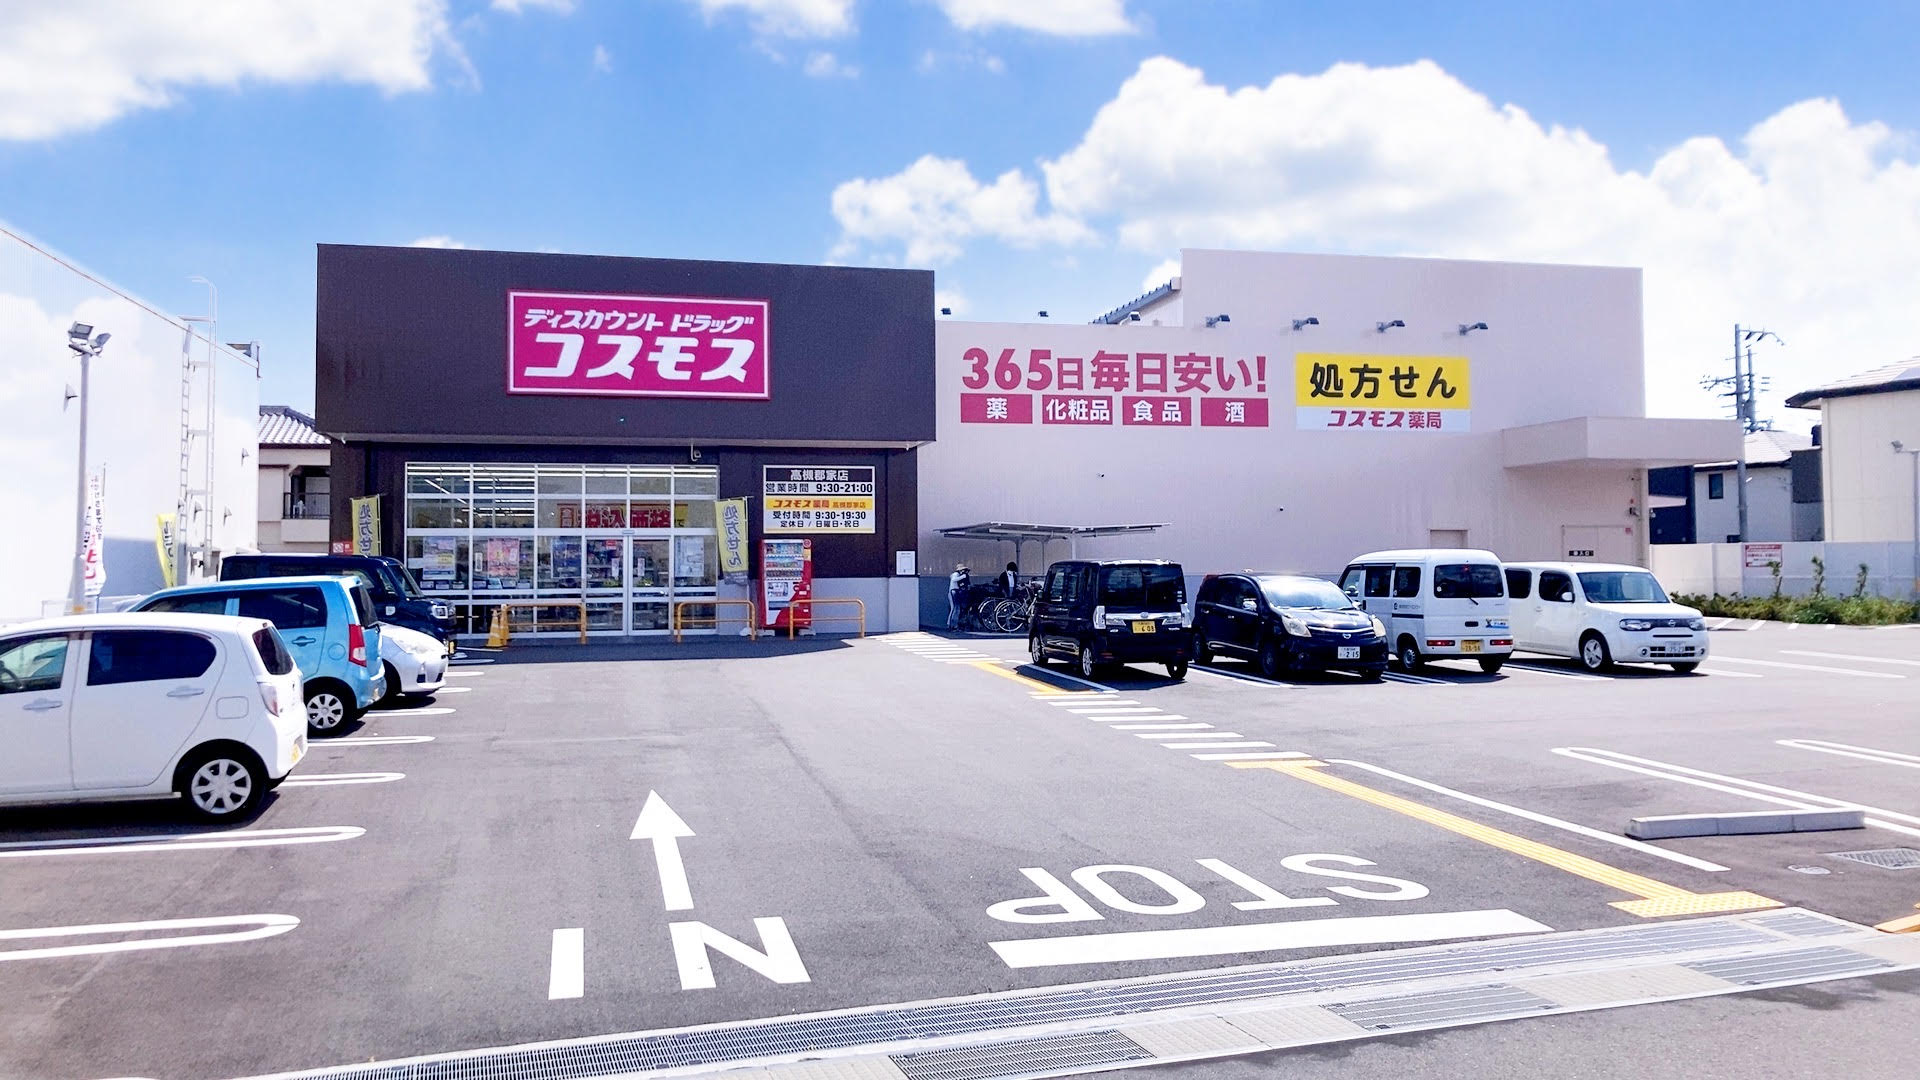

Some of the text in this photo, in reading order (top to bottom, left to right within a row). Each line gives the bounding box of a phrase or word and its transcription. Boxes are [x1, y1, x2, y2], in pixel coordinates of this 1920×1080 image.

[524, 308, 754, 333] ディスカウント ドラッグ
[523, 332, 755, 383] コスモス
[1309, 362, 1457, 399] 処方せん
[986, 398, 1245, 423] 薬 化粧品 食品 酒
[1327, 409, 1442, 429] コスモス薬局
[790, 469, 849, 481] 高槻郡家店
[765, 483, 873, 493] 営業時間 9:30-21:00
[773, 499, 830, 508] コスモス薬局
[772, 511, 866, 520] 受付時間 9:30-19:30
[780, 520, 804, 528] 定休日
[816, 520, 860, 528] 日曜日・祝日
[986, 853, 1430, 924] STOP
[548, 916, 812, 1000] IN
